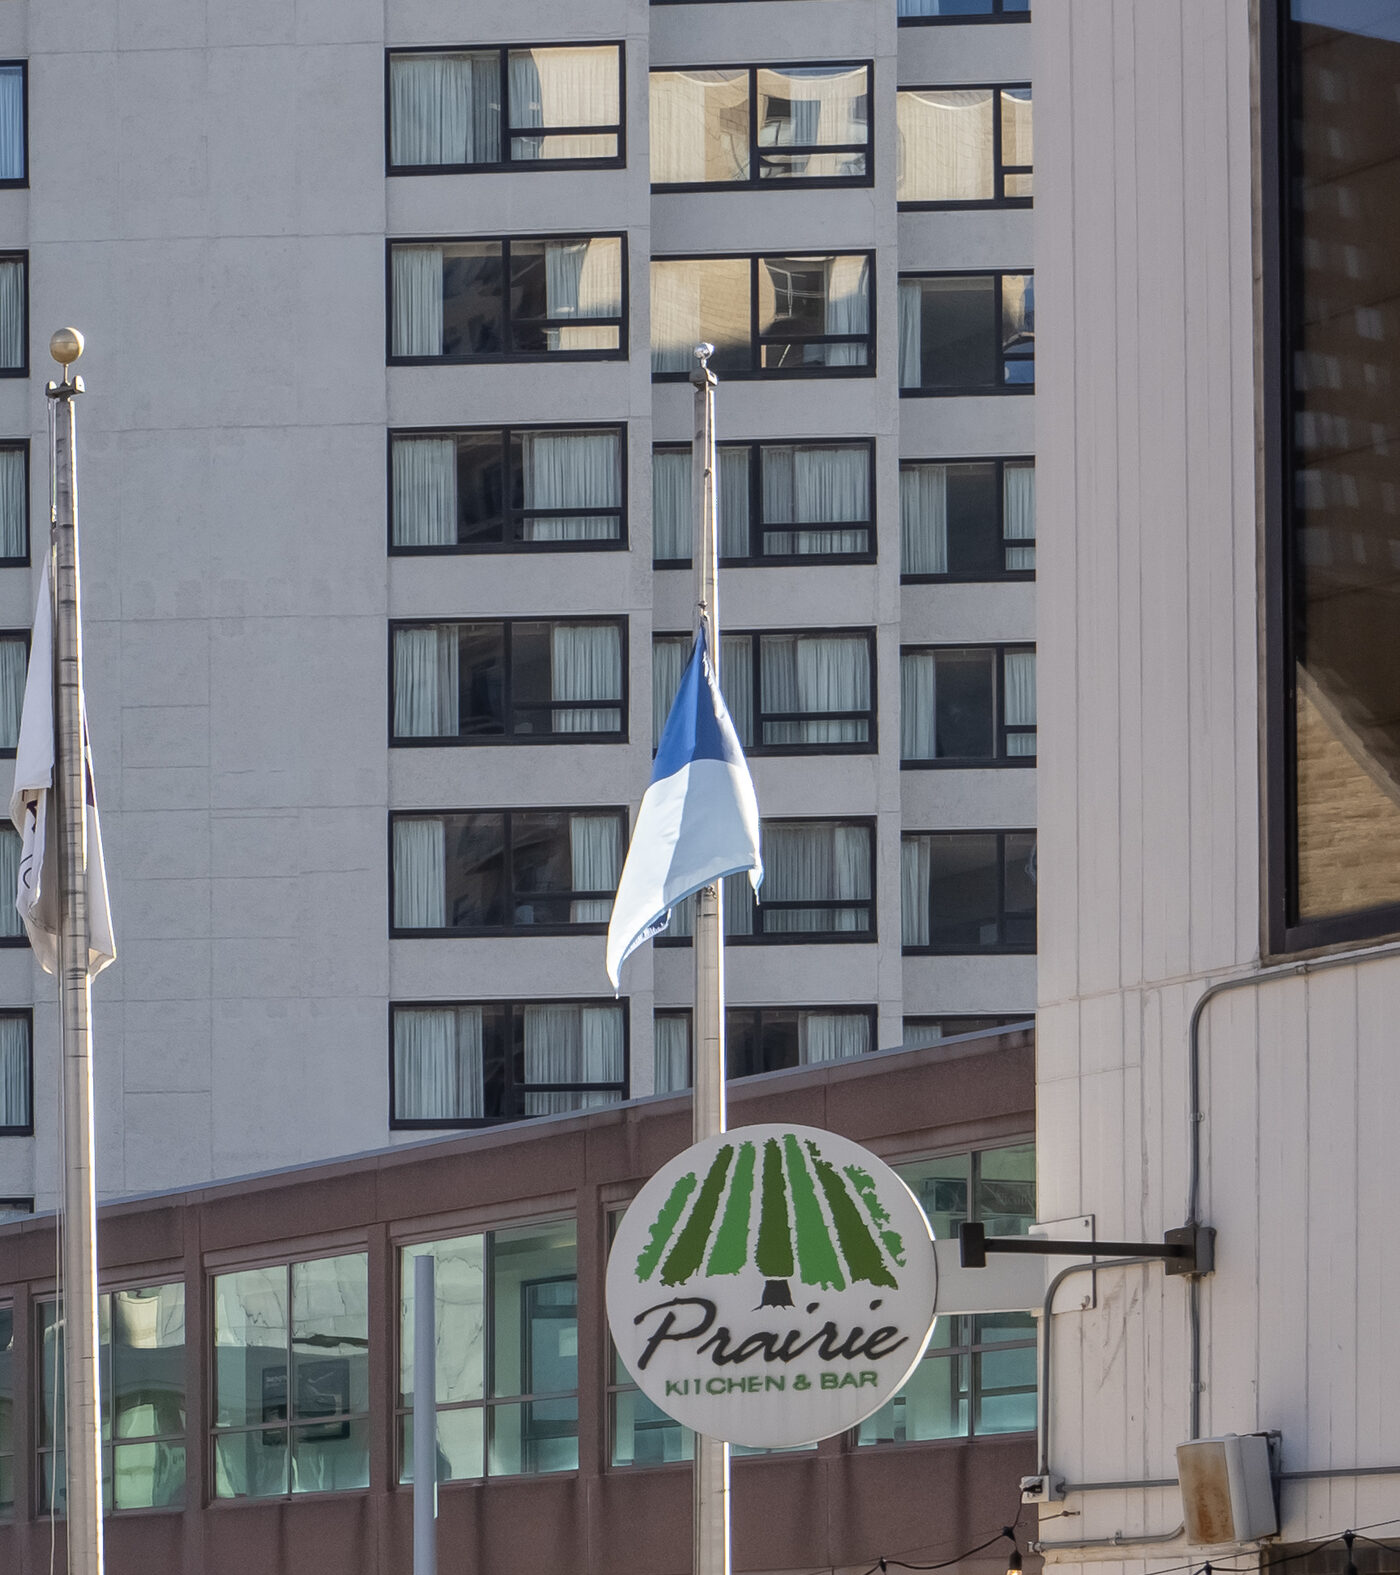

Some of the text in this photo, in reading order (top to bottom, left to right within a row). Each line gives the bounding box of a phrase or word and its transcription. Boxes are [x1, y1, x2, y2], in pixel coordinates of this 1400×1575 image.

[633, 1297, 909, 1370] Prairie
[665, 1370, 878, 1396] KITCHEN & BAR
